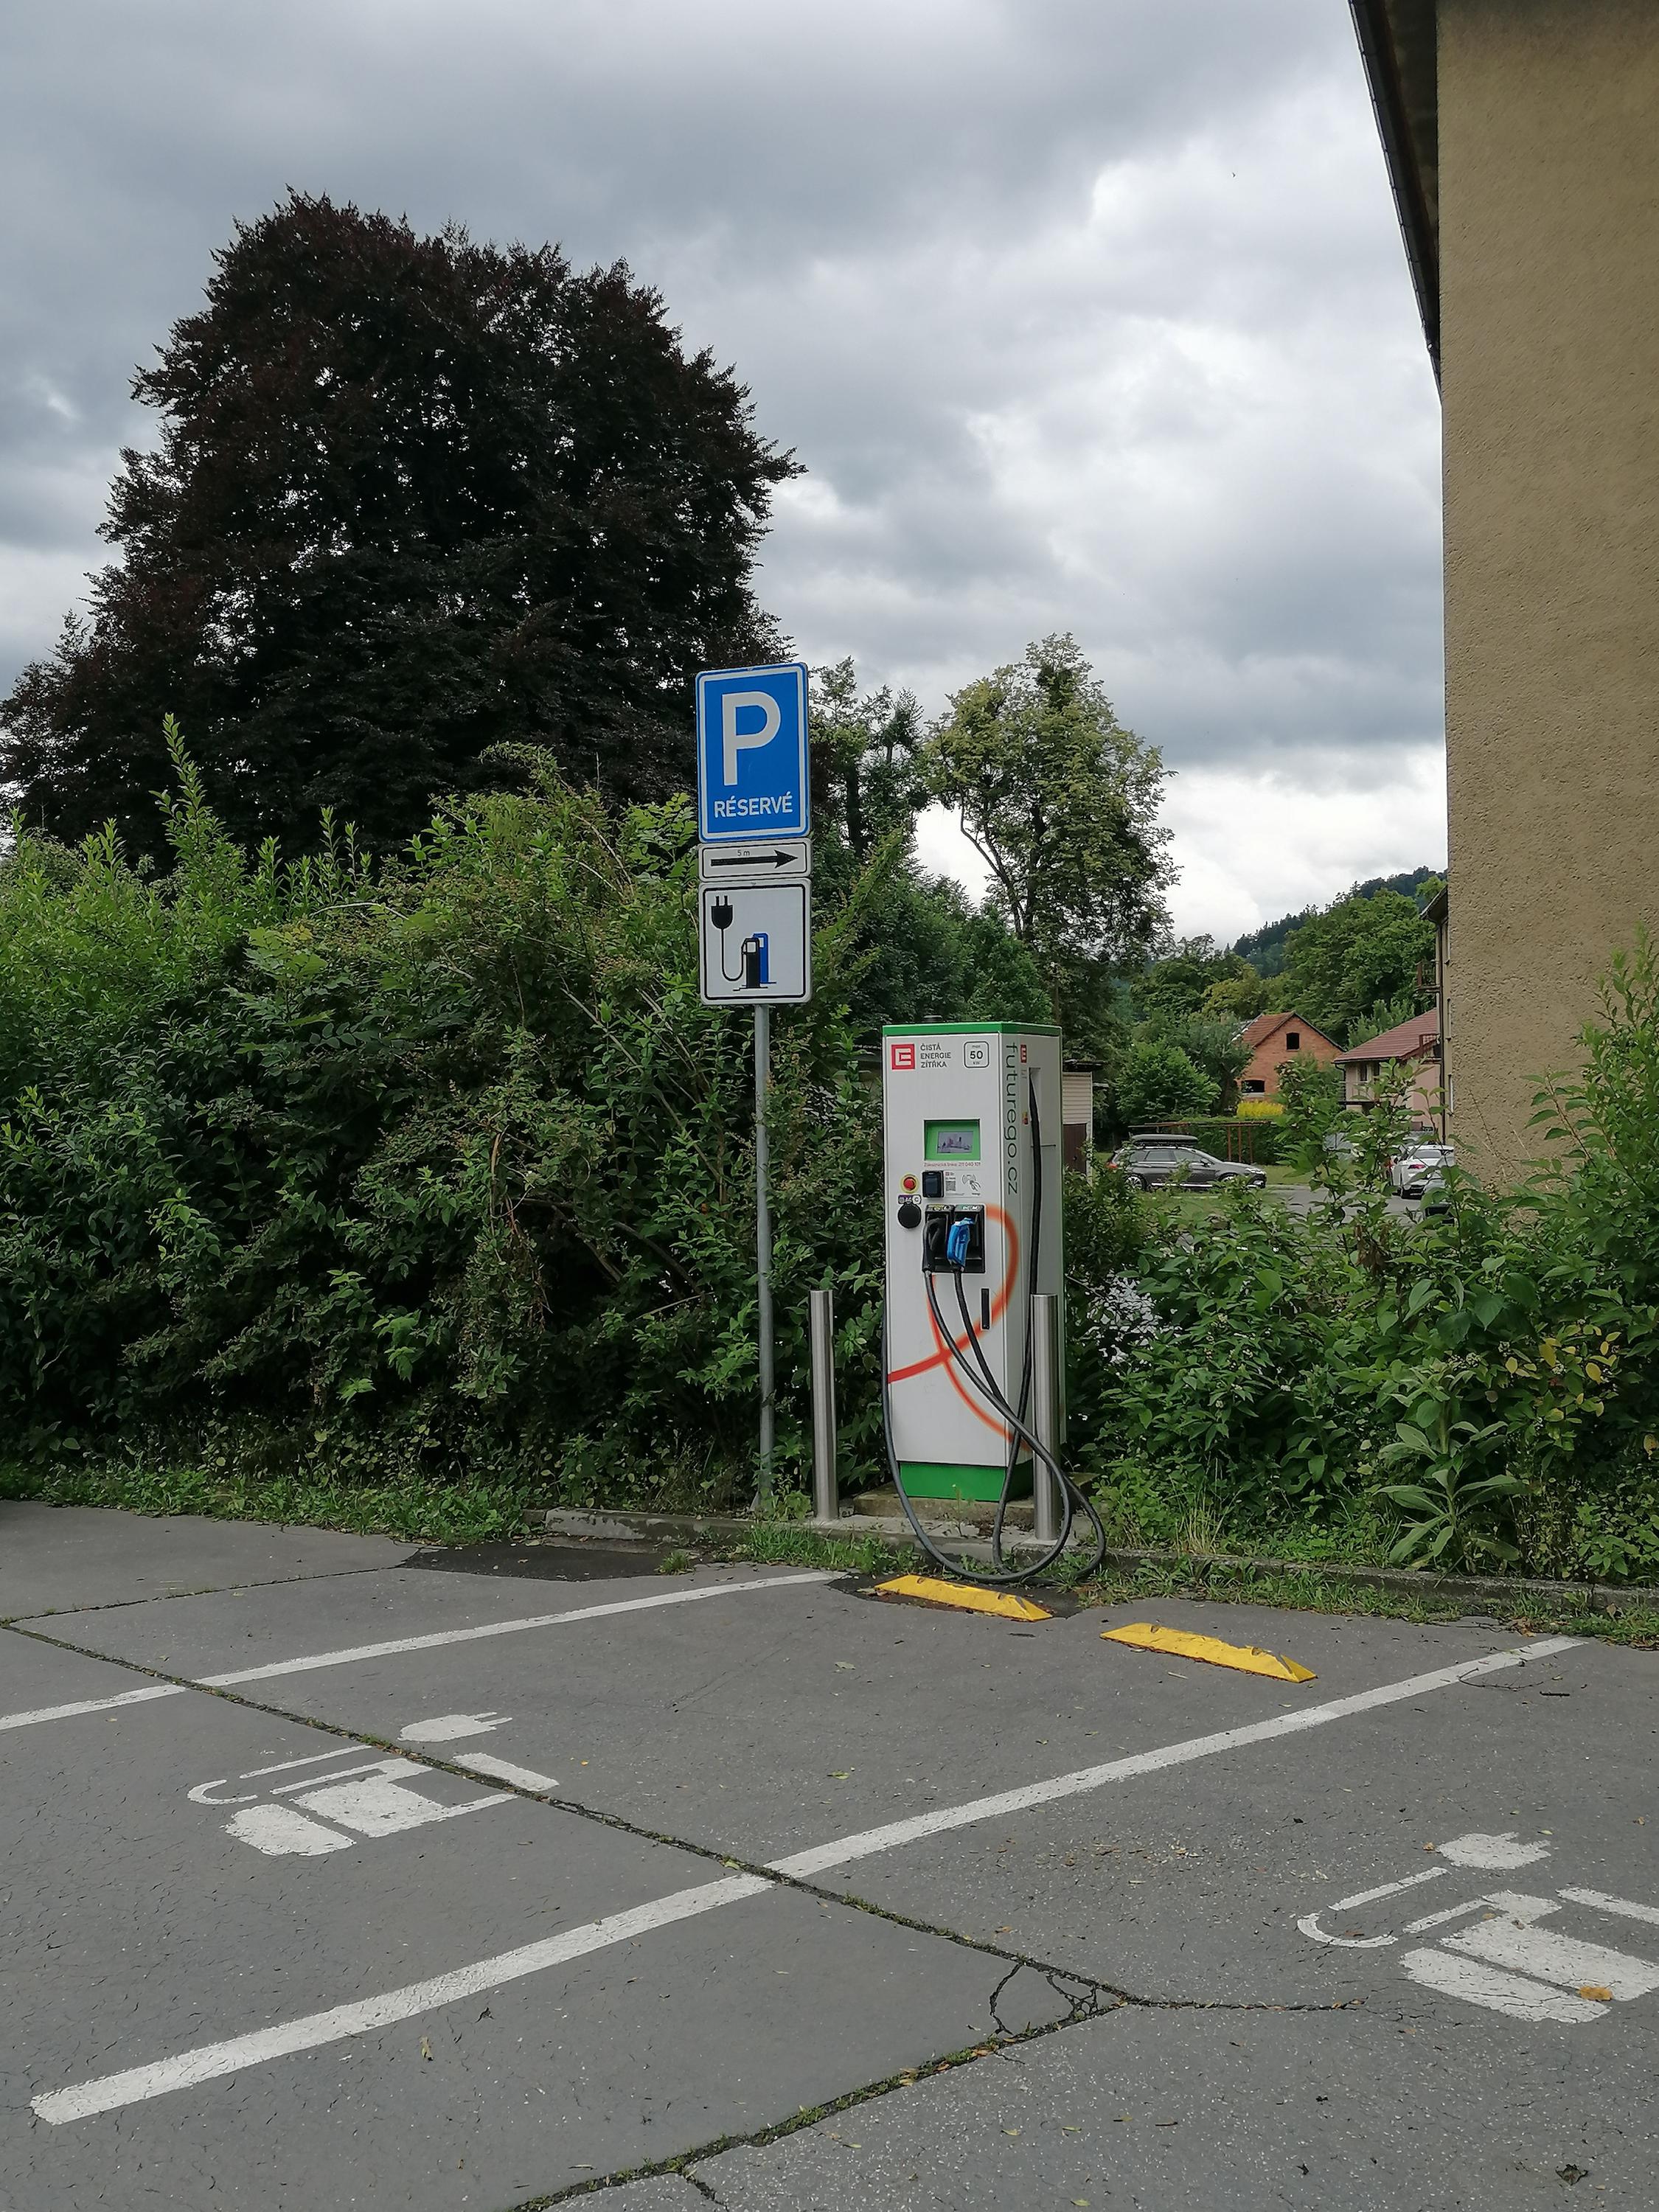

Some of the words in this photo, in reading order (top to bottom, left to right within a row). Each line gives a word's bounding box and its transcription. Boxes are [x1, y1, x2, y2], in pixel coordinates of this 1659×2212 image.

[722, 691, 782, 786] P
[714, 791, 793, 818] RÉSERVÉ
[919, 1042, 942, 1051] ČISTÁ
[970, 1050, 984, 1060] 50
[920, 1060, 947, 1068] ZÍTŘKA
[1004, 1042, 1018, 1195] futurego.cz
